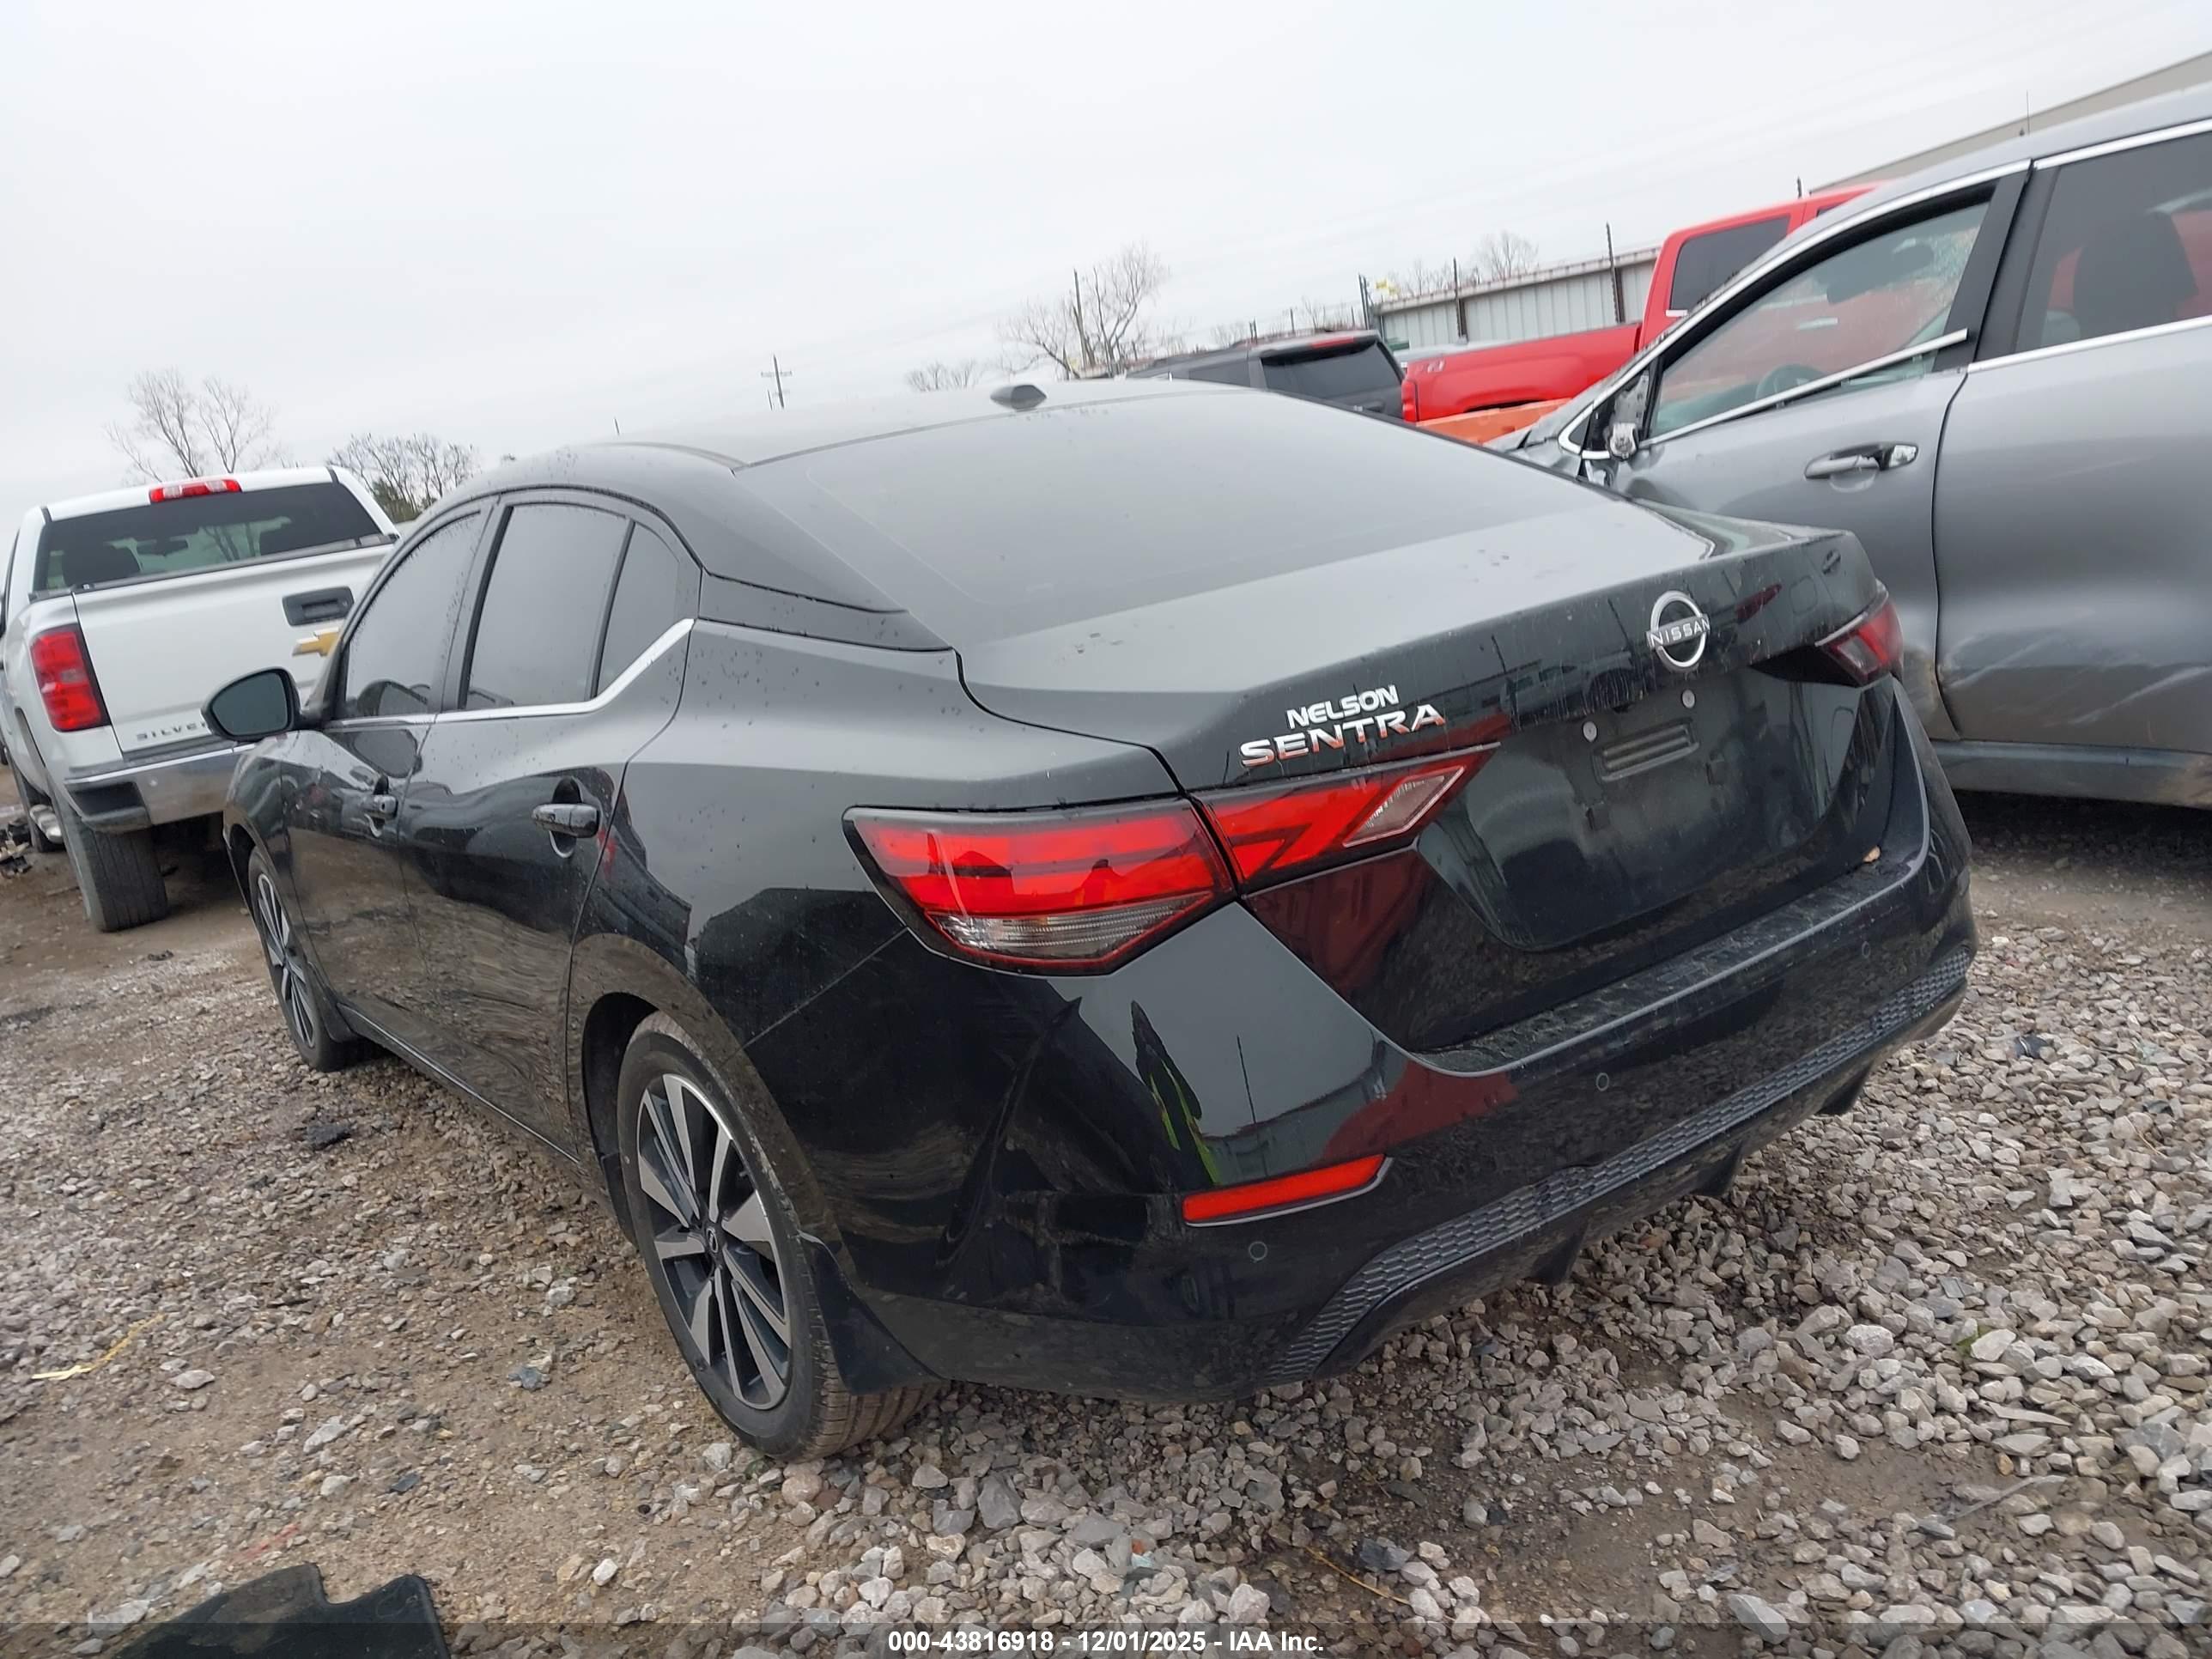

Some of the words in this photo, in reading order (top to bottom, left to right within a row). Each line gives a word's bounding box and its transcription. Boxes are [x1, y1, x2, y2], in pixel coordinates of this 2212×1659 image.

[1650, 617, 1711, 647] NISSAN
[1286, 684, 1400, 729] NELSON
[1240, 703, 1446, 767] SENTRA
